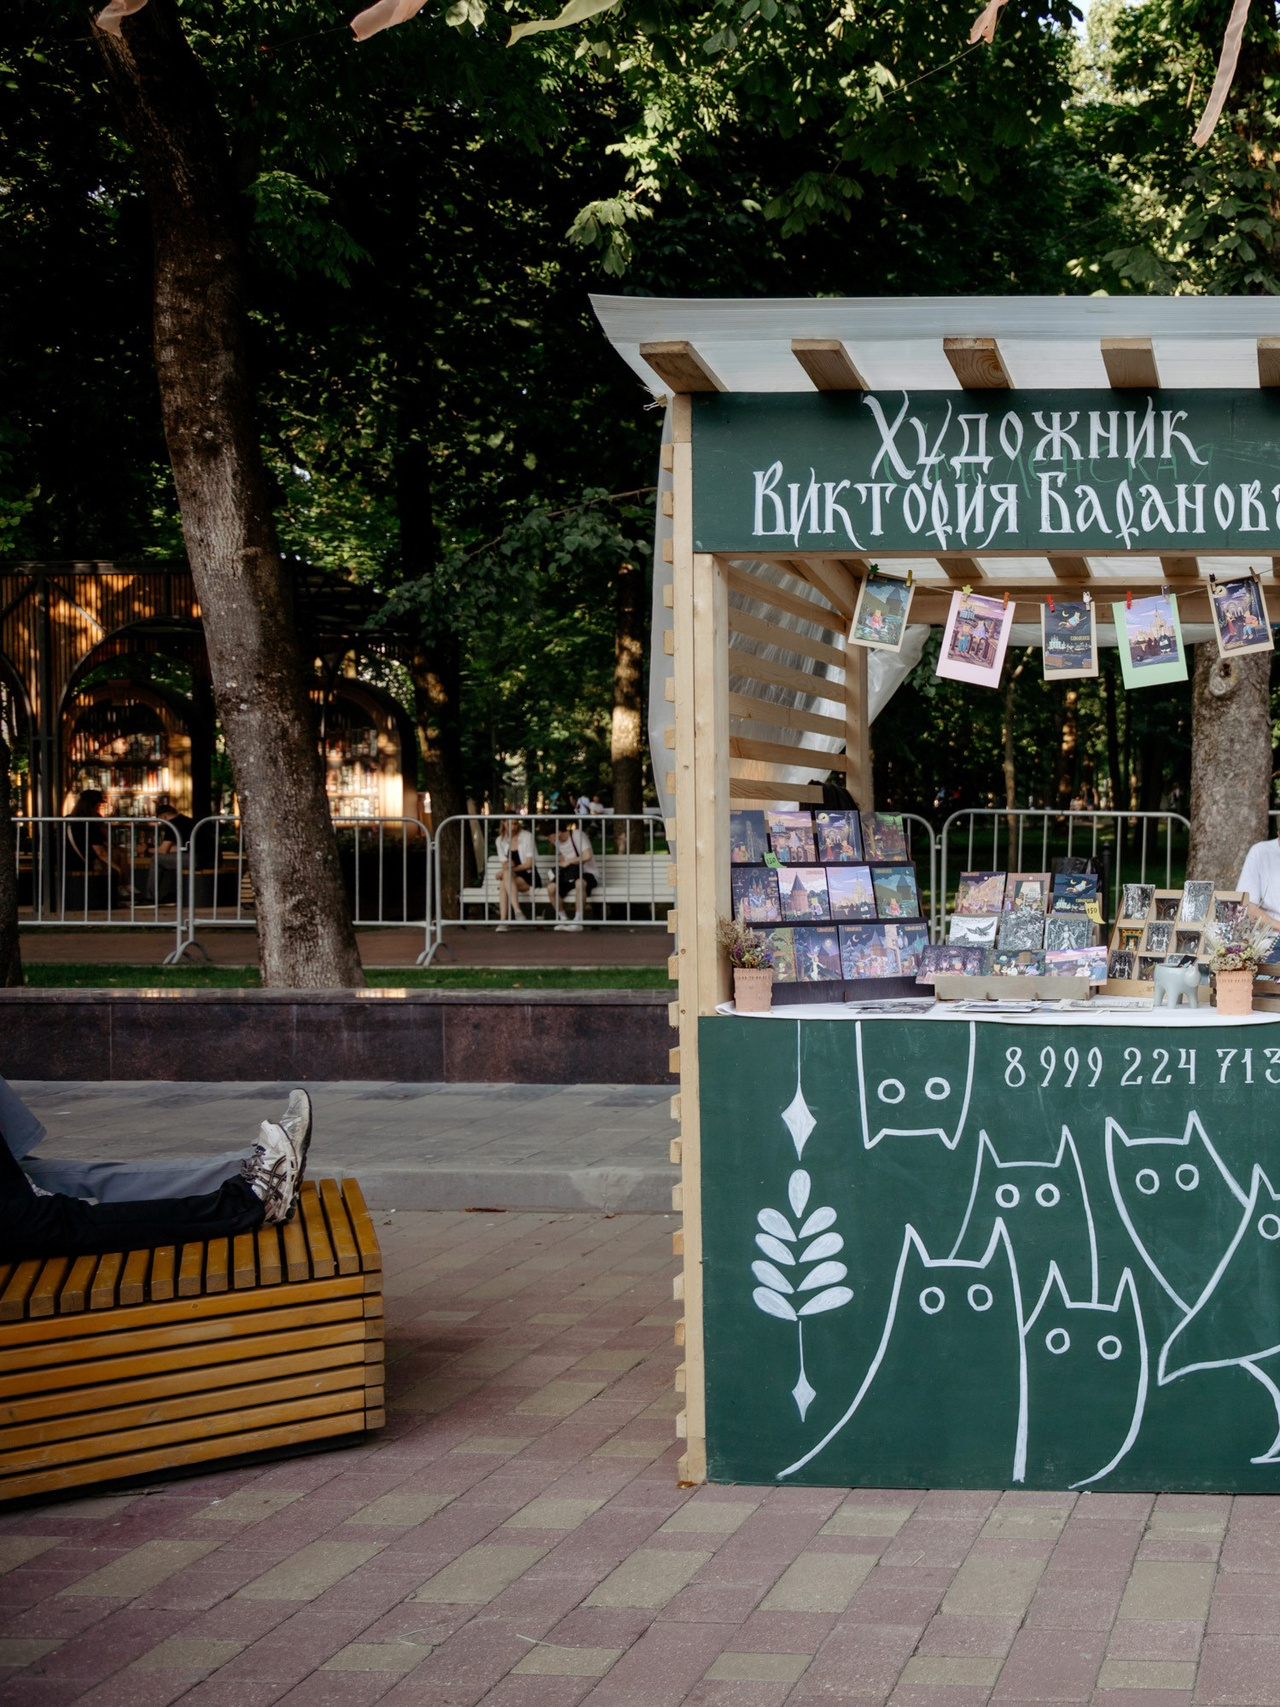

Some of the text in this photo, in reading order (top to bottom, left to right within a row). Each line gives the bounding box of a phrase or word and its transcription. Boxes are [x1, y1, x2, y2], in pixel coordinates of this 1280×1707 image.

[766, 857, 777, 865] 150
[1087, 907, 1098, 915] 150
[1004, 1046, 1026, 1088] 8
[1039, 1046, 1103, 1088] 999
[1120, 1047, 1197, 1087] 224
